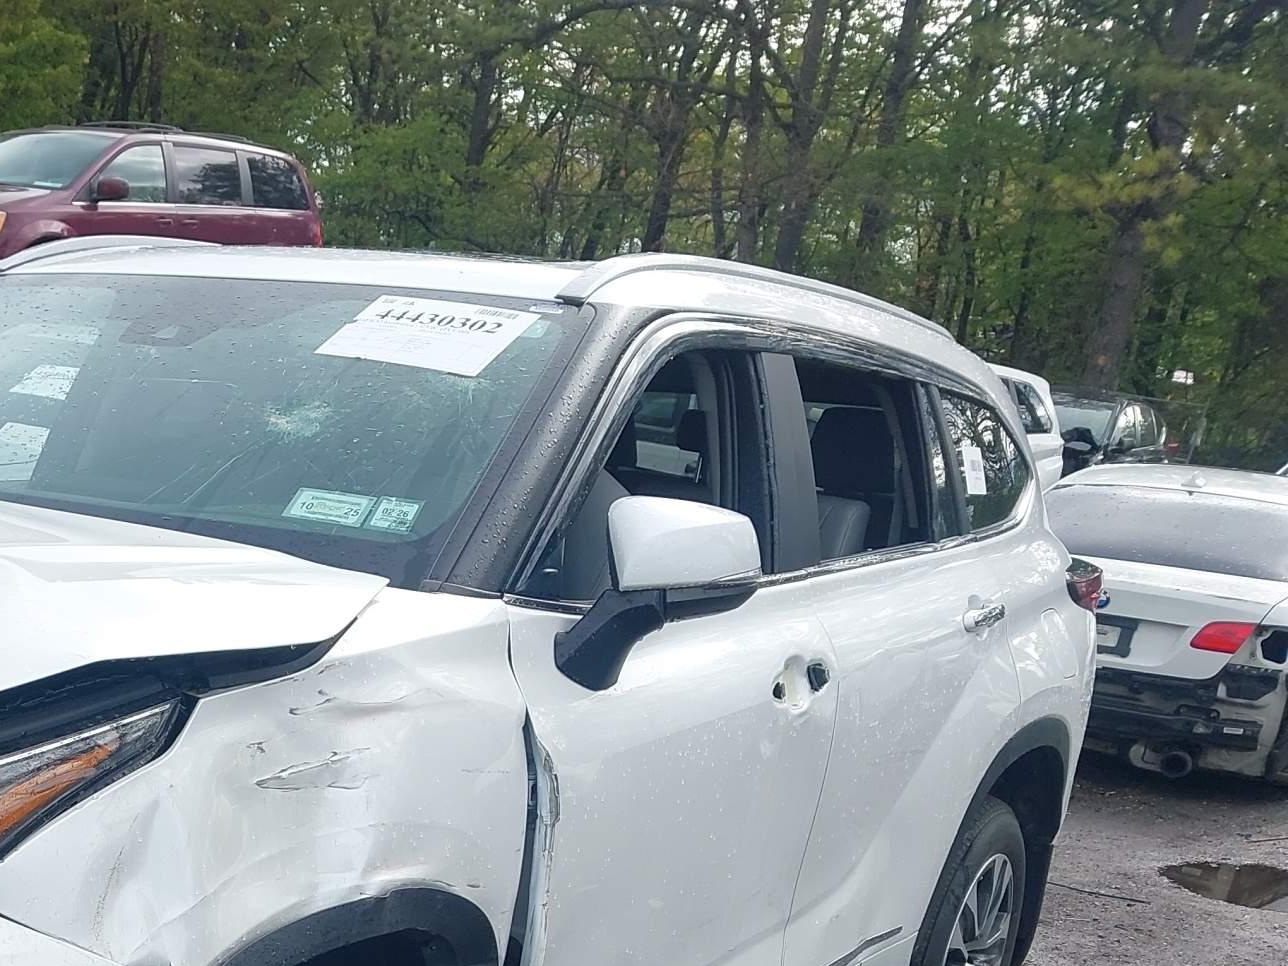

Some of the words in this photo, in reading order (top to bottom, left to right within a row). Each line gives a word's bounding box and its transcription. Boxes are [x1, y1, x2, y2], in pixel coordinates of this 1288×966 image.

[376, 309, 503, 333] 44430302
[299, 501, 314, 510] 10
[343, 507, 361, 517] 25
